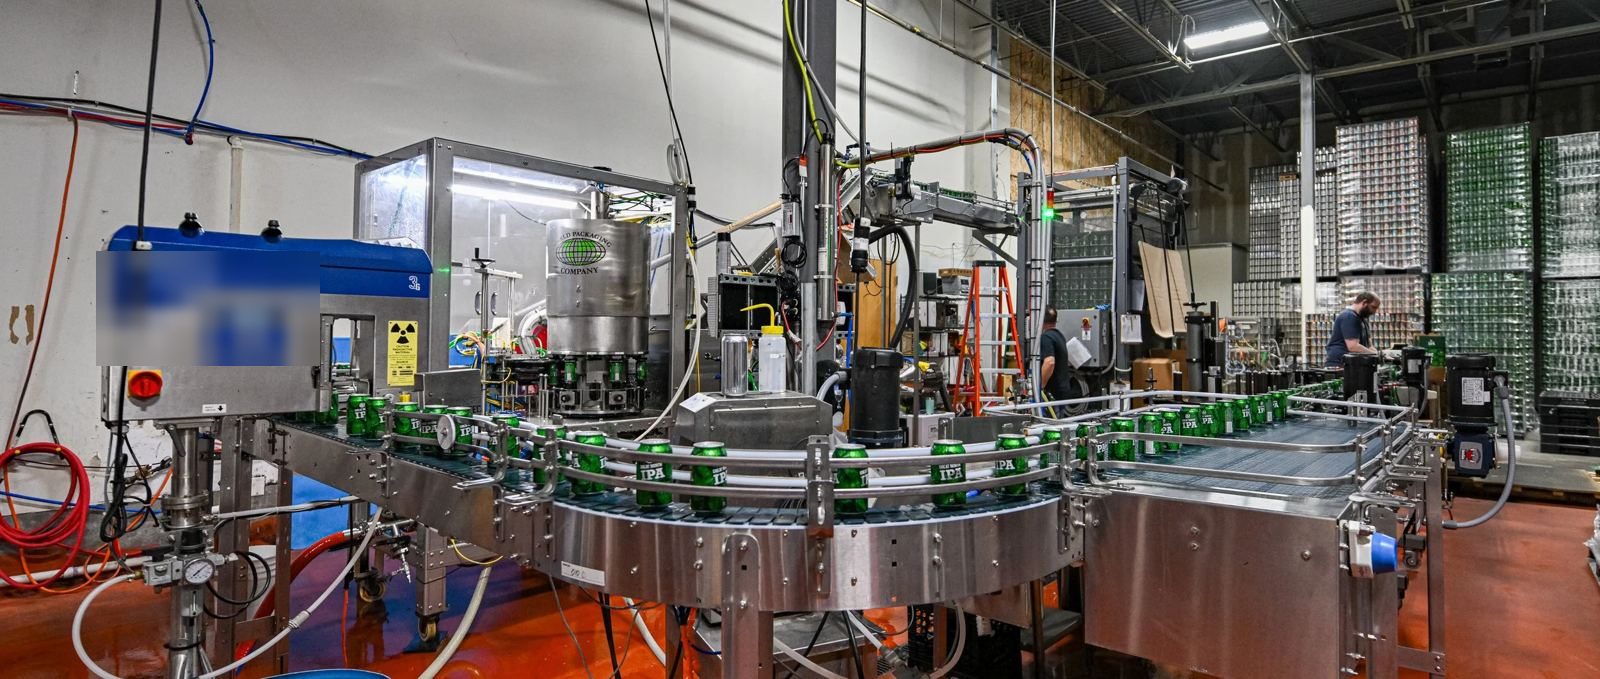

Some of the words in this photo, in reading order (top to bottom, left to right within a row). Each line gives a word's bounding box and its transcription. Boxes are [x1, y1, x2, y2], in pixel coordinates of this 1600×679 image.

[560, 266, 599, 275] COMPANY
[1182, 421, 1198, 429] IPA
[640, 467, 665, 481] IPA
[939, 468, 963, 481] IPA
